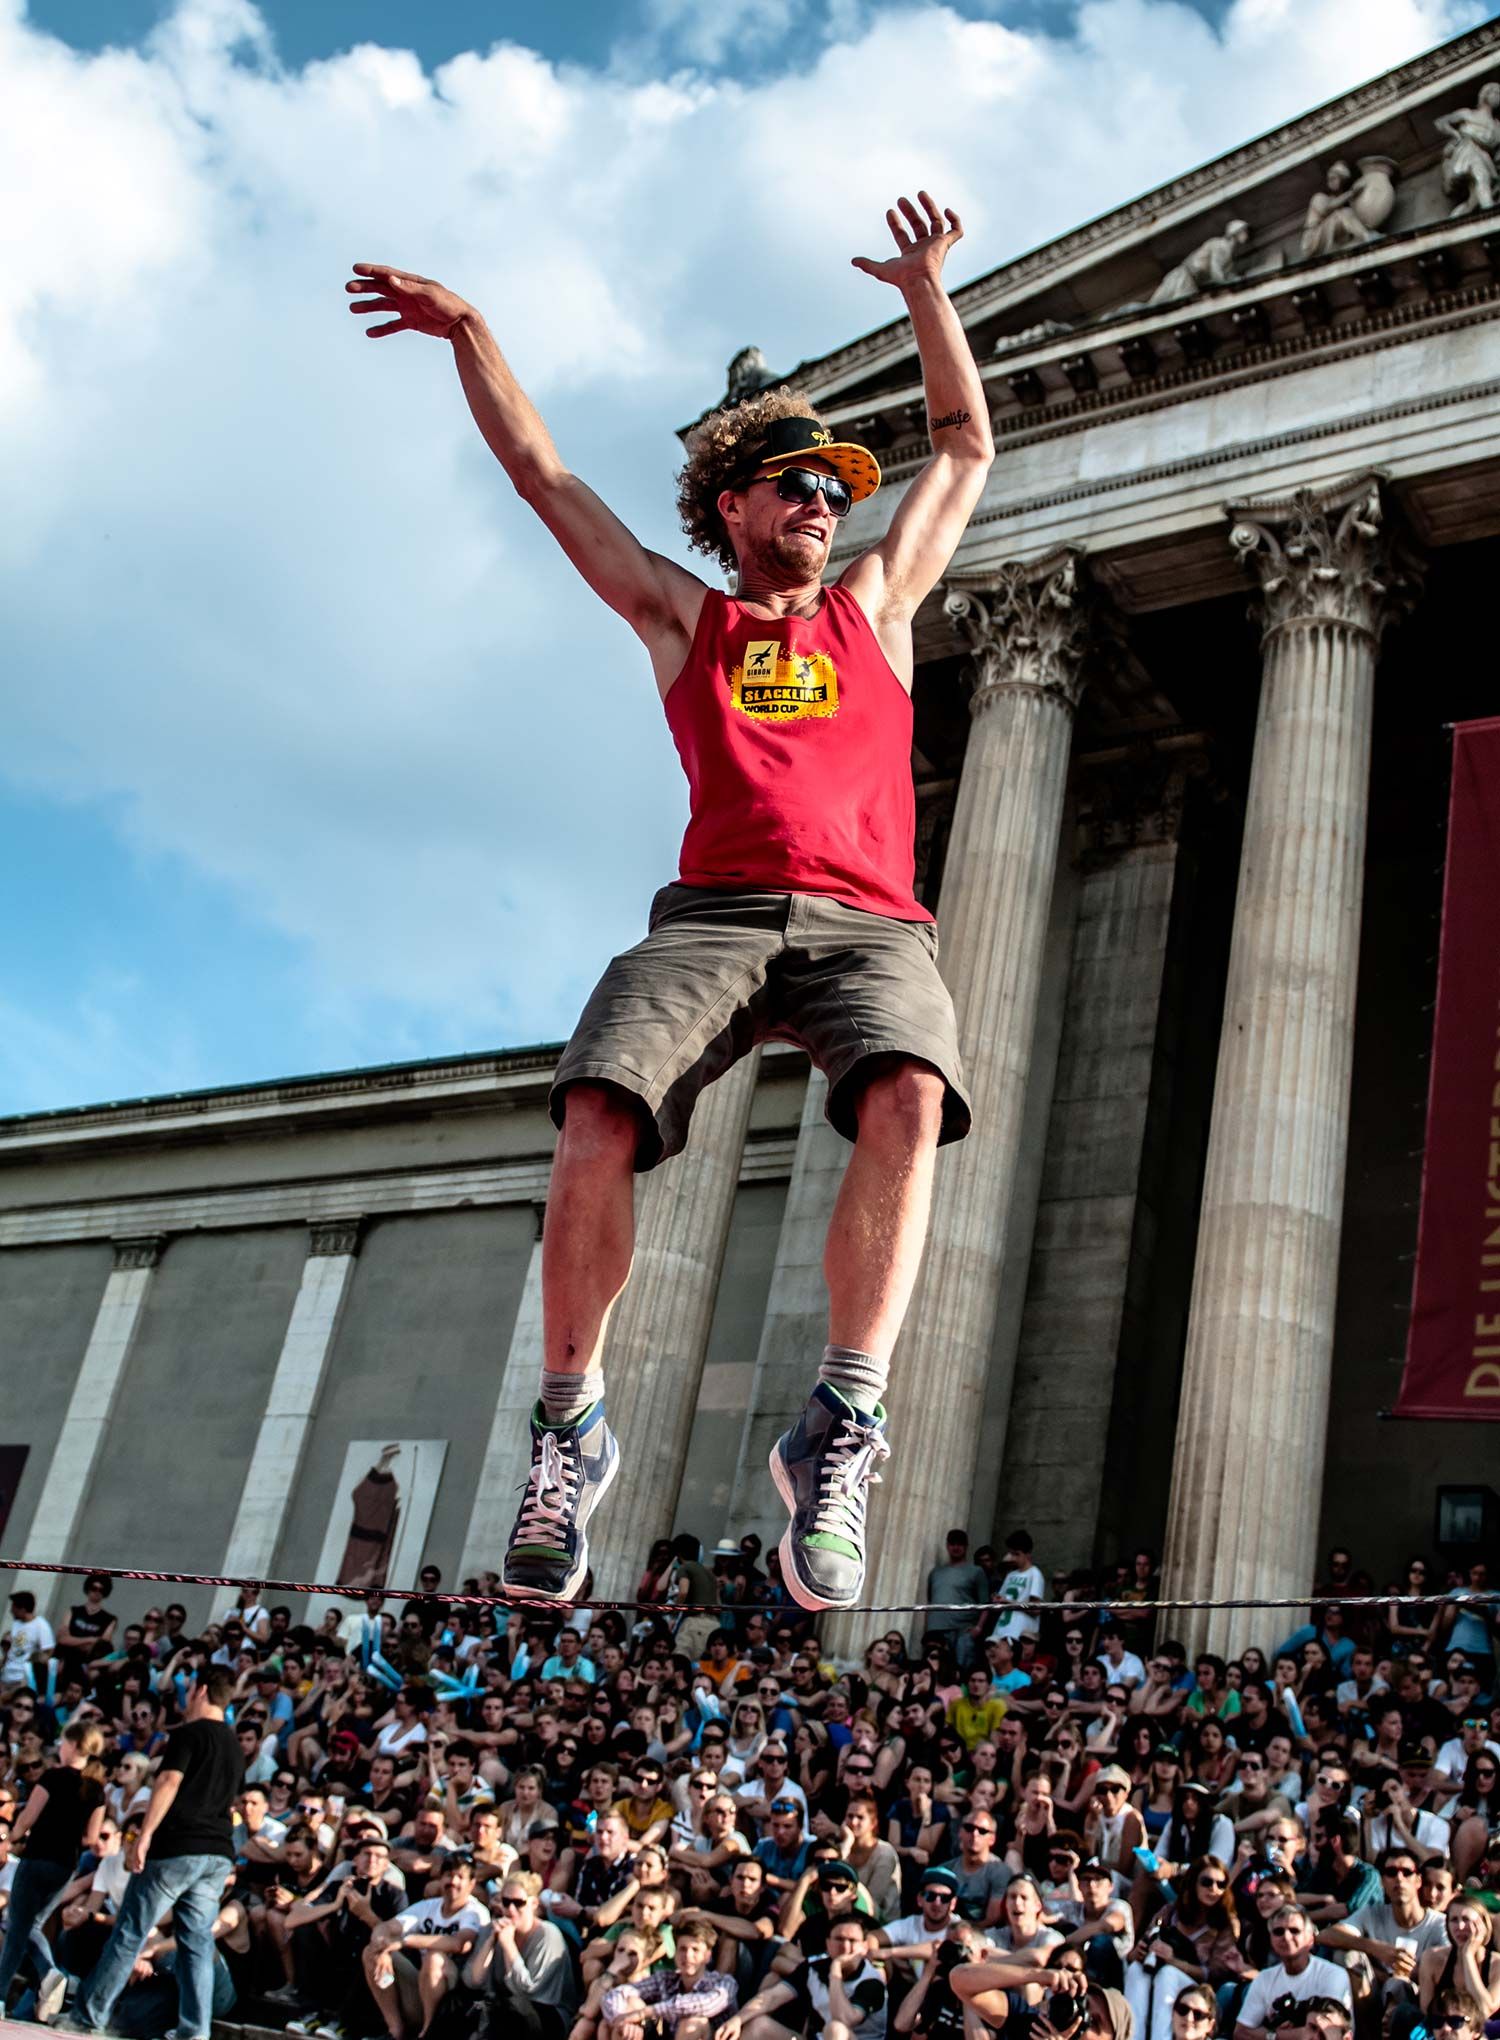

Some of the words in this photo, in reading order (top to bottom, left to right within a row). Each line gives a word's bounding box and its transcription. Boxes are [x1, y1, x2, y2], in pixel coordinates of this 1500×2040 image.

[747, 668, 771, 676] GIBBON
[744, 688, 823, 702] SLACKLINE
[744, 704, 778, 713] WORLD
[780, 704, 799, 713] CUP
